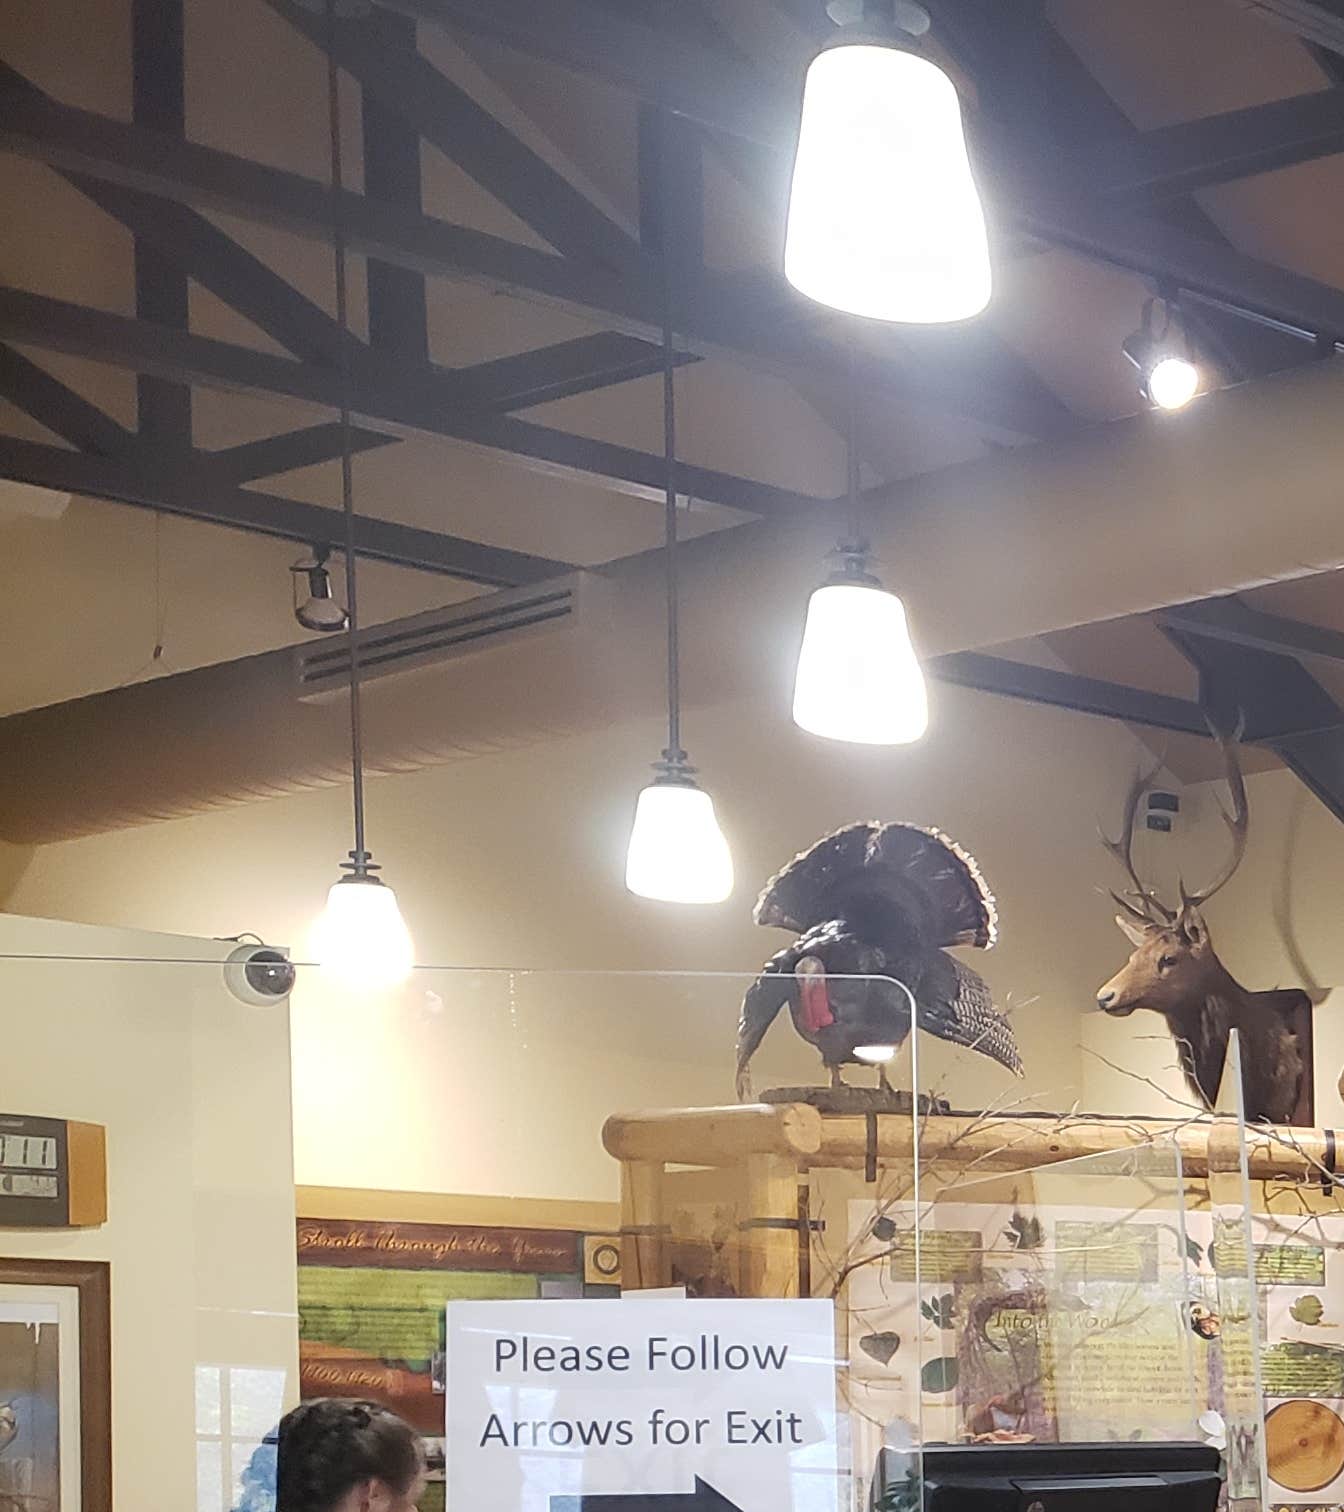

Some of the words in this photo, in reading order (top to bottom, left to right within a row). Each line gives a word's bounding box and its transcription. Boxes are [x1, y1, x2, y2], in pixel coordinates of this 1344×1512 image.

[495, 1336, 630, 1372] Please
[649, 1335, 788, 1371] Follow
[479, 1413, 633, 1447] Arrows
[648, 1409, 710, 1445] for
[726, 1410, 803, 1444] Exit
